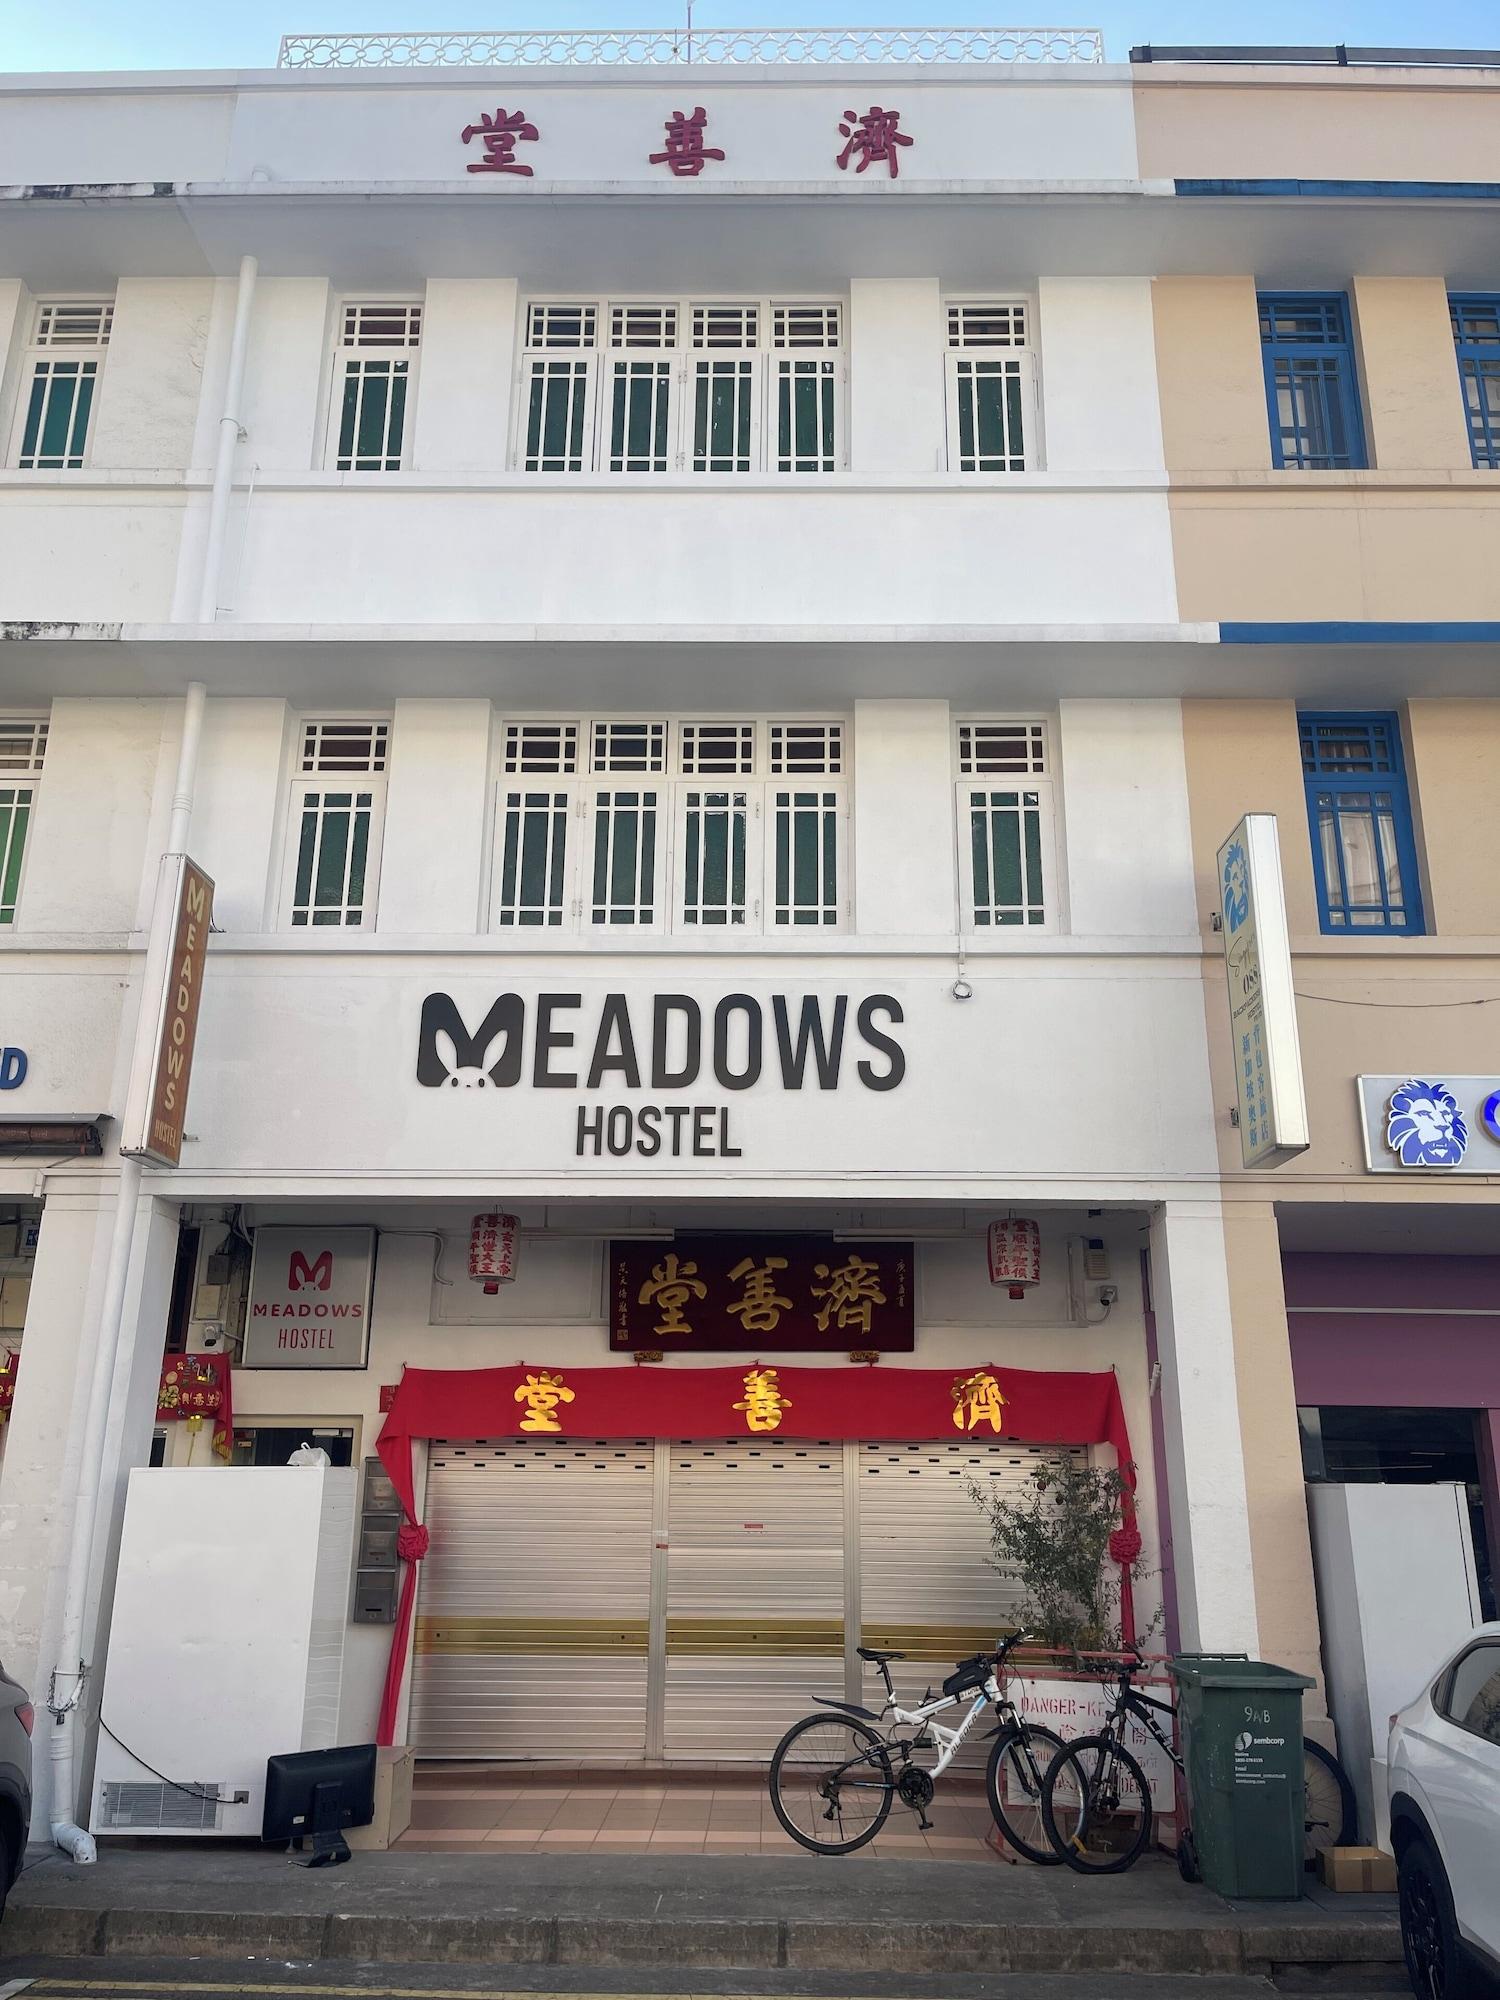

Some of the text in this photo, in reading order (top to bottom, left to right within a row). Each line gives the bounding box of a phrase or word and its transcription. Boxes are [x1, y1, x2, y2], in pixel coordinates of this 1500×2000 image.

[165, 877, 205, 1111] MEADOWS
[417, 992, 906, 1091] MEADOWS
[154, 1119, 177, 1149] HOSTEL
[575, 1105, 742, 1157] HOSTEL
[253, 1303, 363, 1317] MEADOWS
[278, 1328, 335, 1349] HOSTEL
[1253, 1737, 1285, 1746] sembcorp
